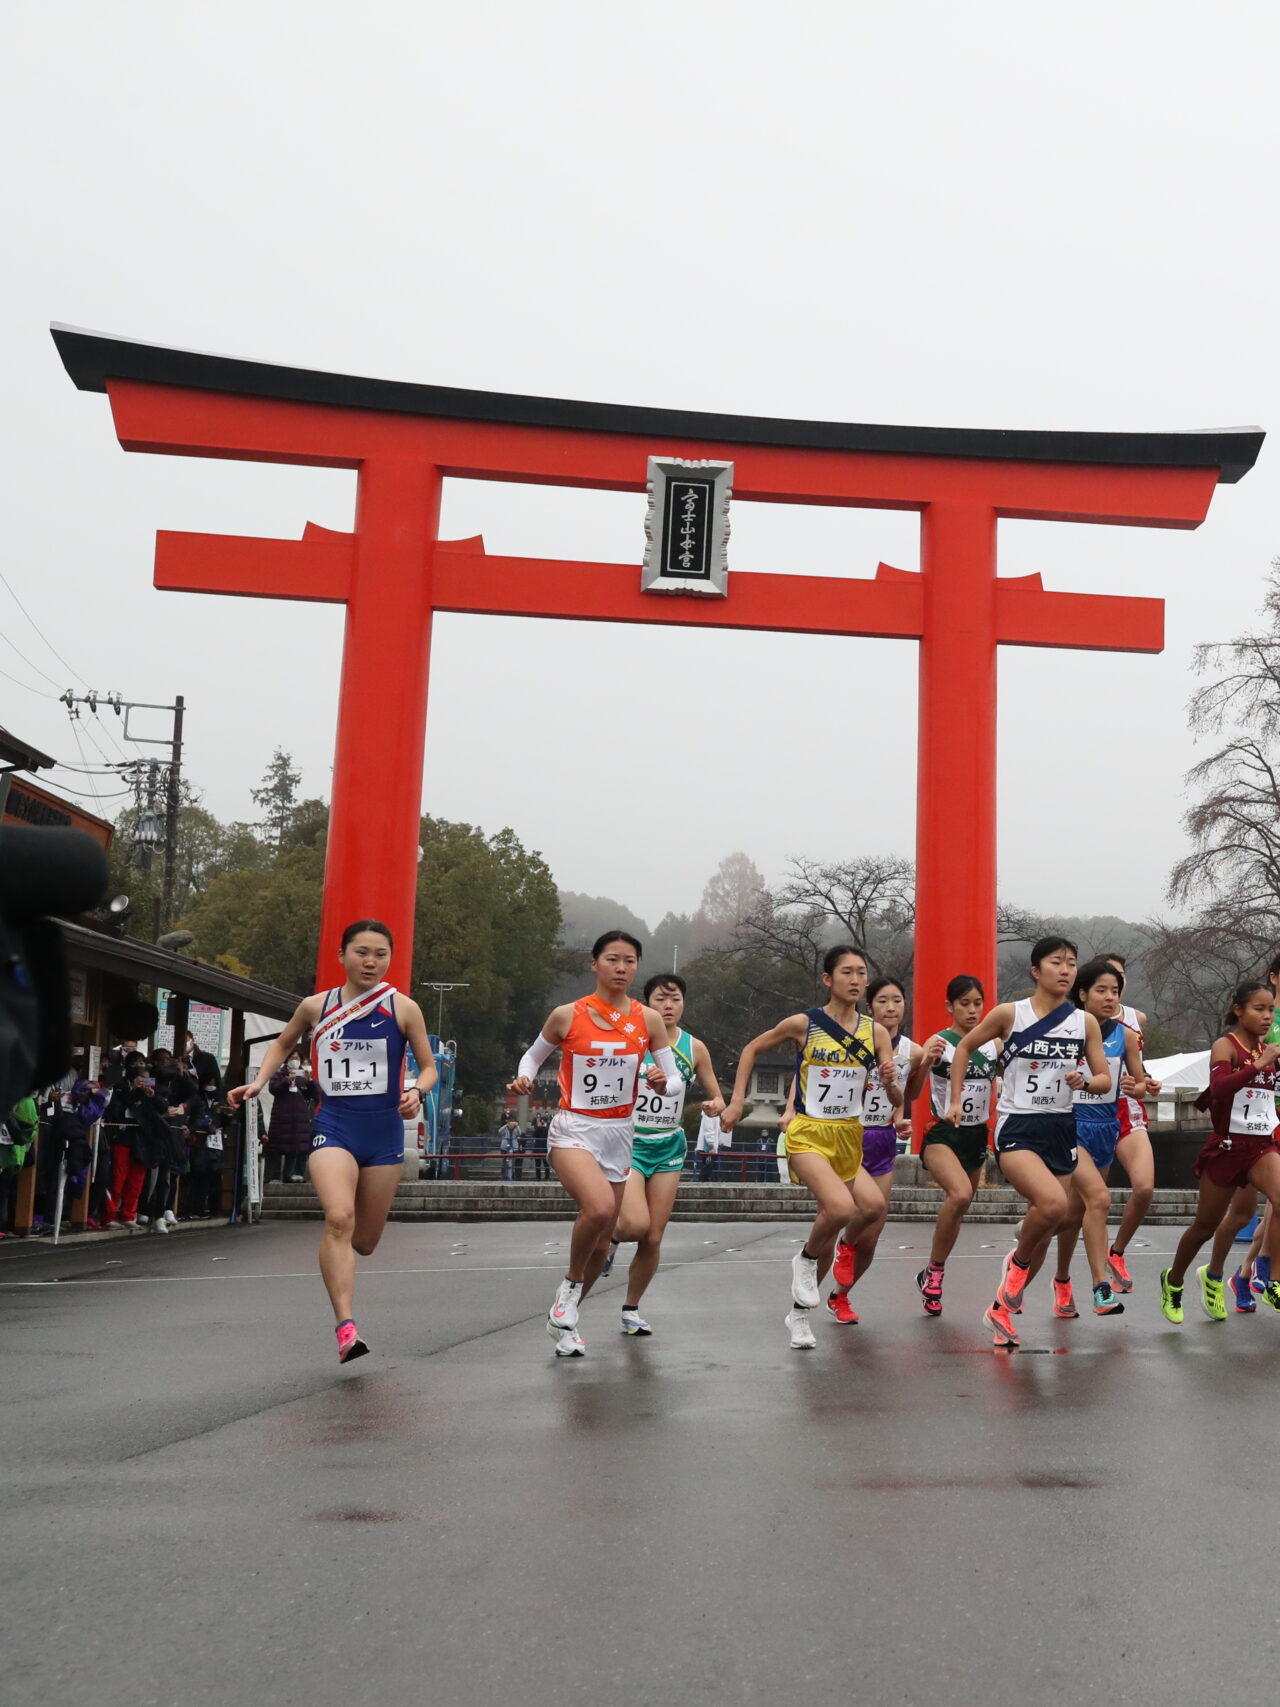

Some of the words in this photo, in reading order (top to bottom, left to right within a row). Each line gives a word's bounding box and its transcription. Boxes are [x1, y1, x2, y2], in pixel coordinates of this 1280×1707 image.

[343, 1042, 373, 1052] アルト
[599, 1058, 627, 1068] アルト
[1041, 1061, 1067, 1070] アルト
[324, 1058, 377, 1079] 11-1
[833, 1069, 858, 1079] アルト
[331, 1081, 373, 1092] 順天堂大
[583, 1074, 624, 1093] 9-1
[1026, 1075, 1061, 1093] 5-1
[818, 1084, 854, 1102] 7-1
[590, 1095, 619, 1106] 拓殖大
[635, 1095, 679, 1114] 20-1
[1031, 1097, 1056, 1105] 関西大
[823, 1106, 848, 1115] 城西大
[1246, 1122, 1270, 1131] 名城大
